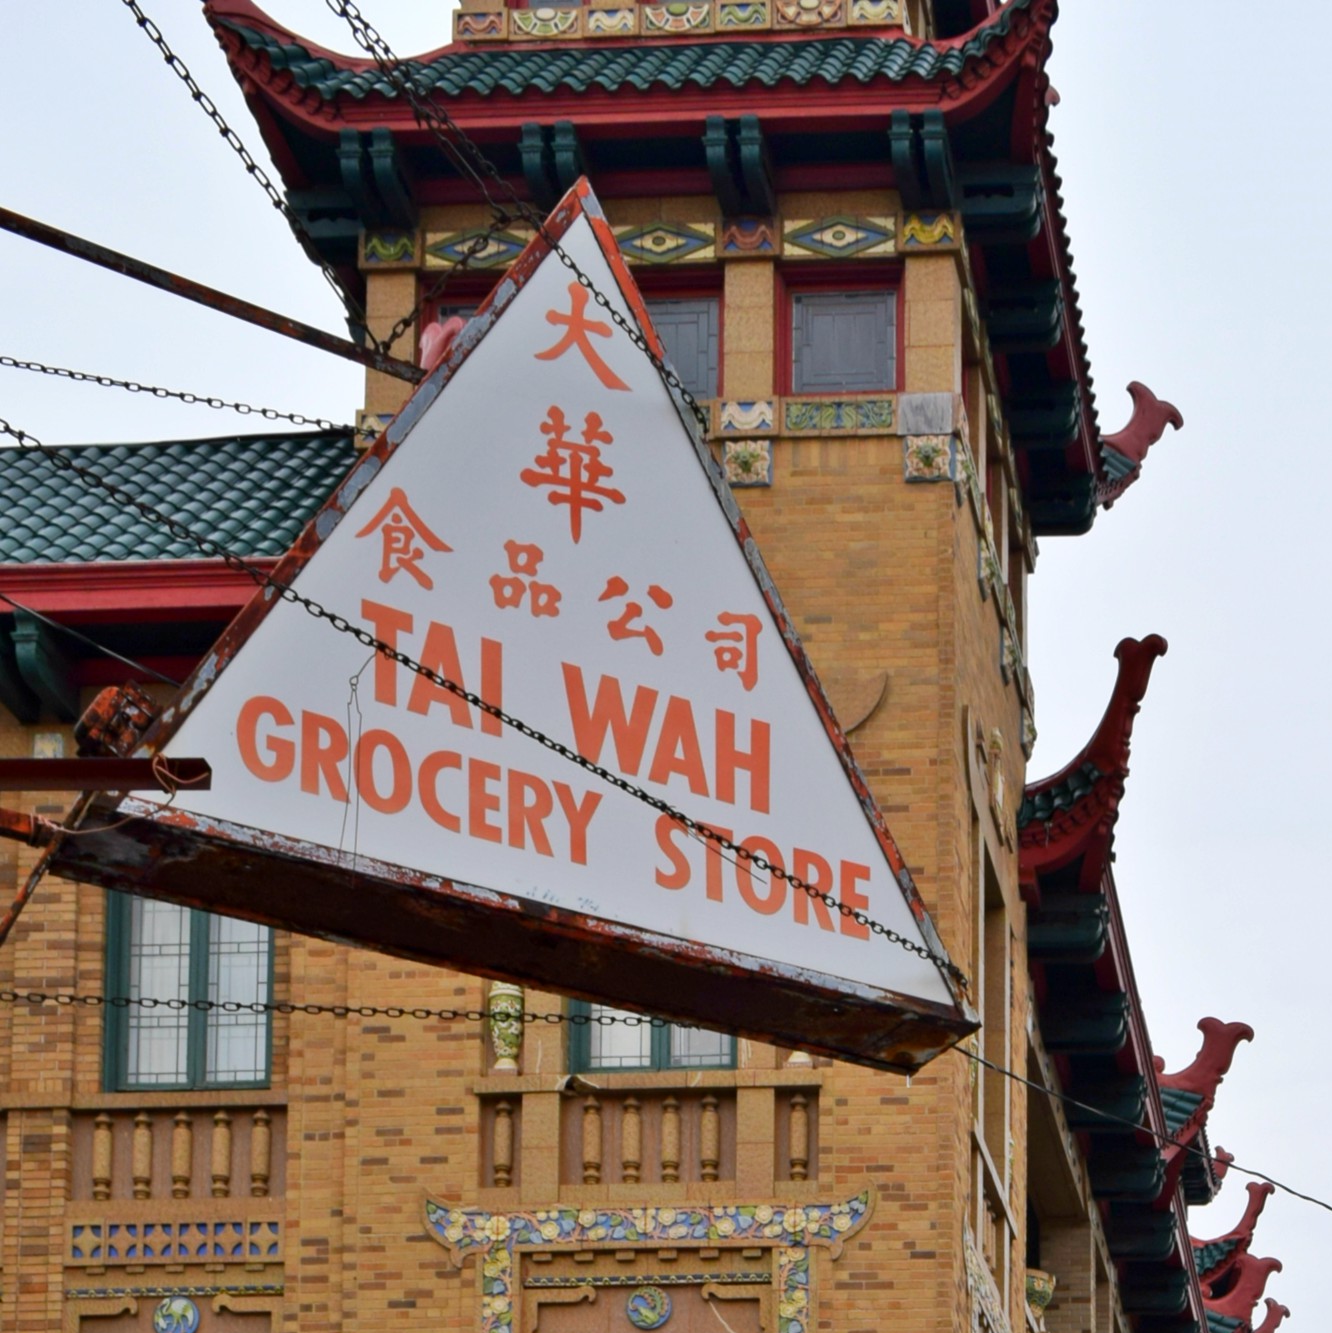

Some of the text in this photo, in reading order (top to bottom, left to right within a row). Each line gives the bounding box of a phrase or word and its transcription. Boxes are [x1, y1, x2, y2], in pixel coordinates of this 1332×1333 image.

[236, 695, 871, 942] GROCERY STORE
[361, 598, 772, 814] TAI WAH
